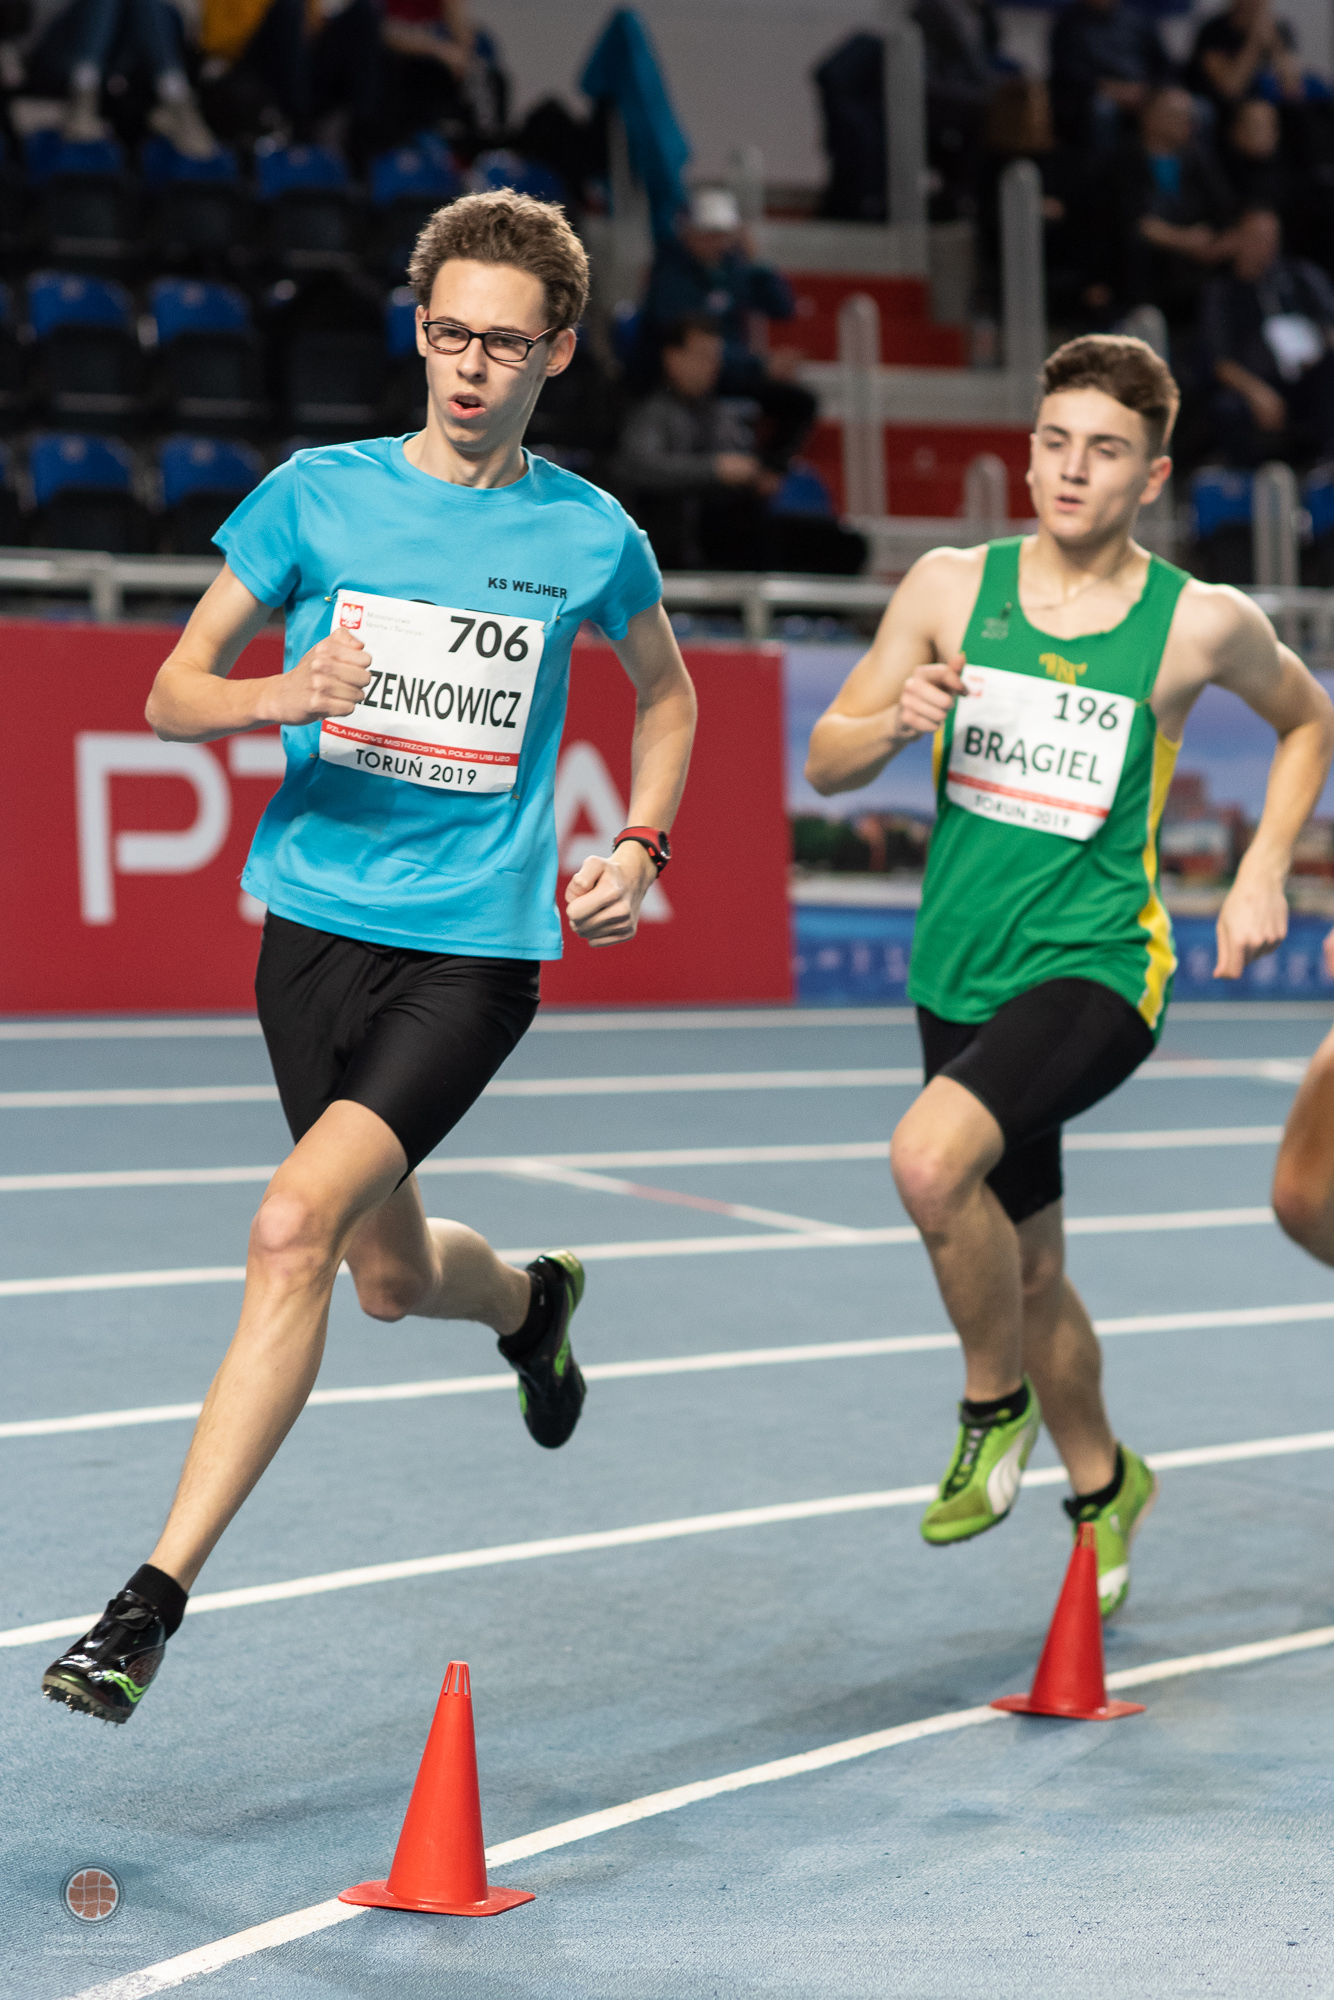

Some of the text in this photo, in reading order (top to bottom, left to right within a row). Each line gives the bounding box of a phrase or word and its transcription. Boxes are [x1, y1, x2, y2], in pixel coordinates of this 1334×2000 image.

[487, 577, 568, 599] KS WEJHER
[447, 615, 529, 662] 706
[357, 669, 522, 729] ZENKOWICZ
[1053, 692, 1119, 731] 196
[325, 723, 511, 763] PZLA HALOWE MISTRZOSTWA POLSKI U18 U20
[963, 725, 1103, 785] BRĄGIEL
[356, 748, 477, 785] TORUŃ 2019
[1032, 808, 1072, 829] 2019
